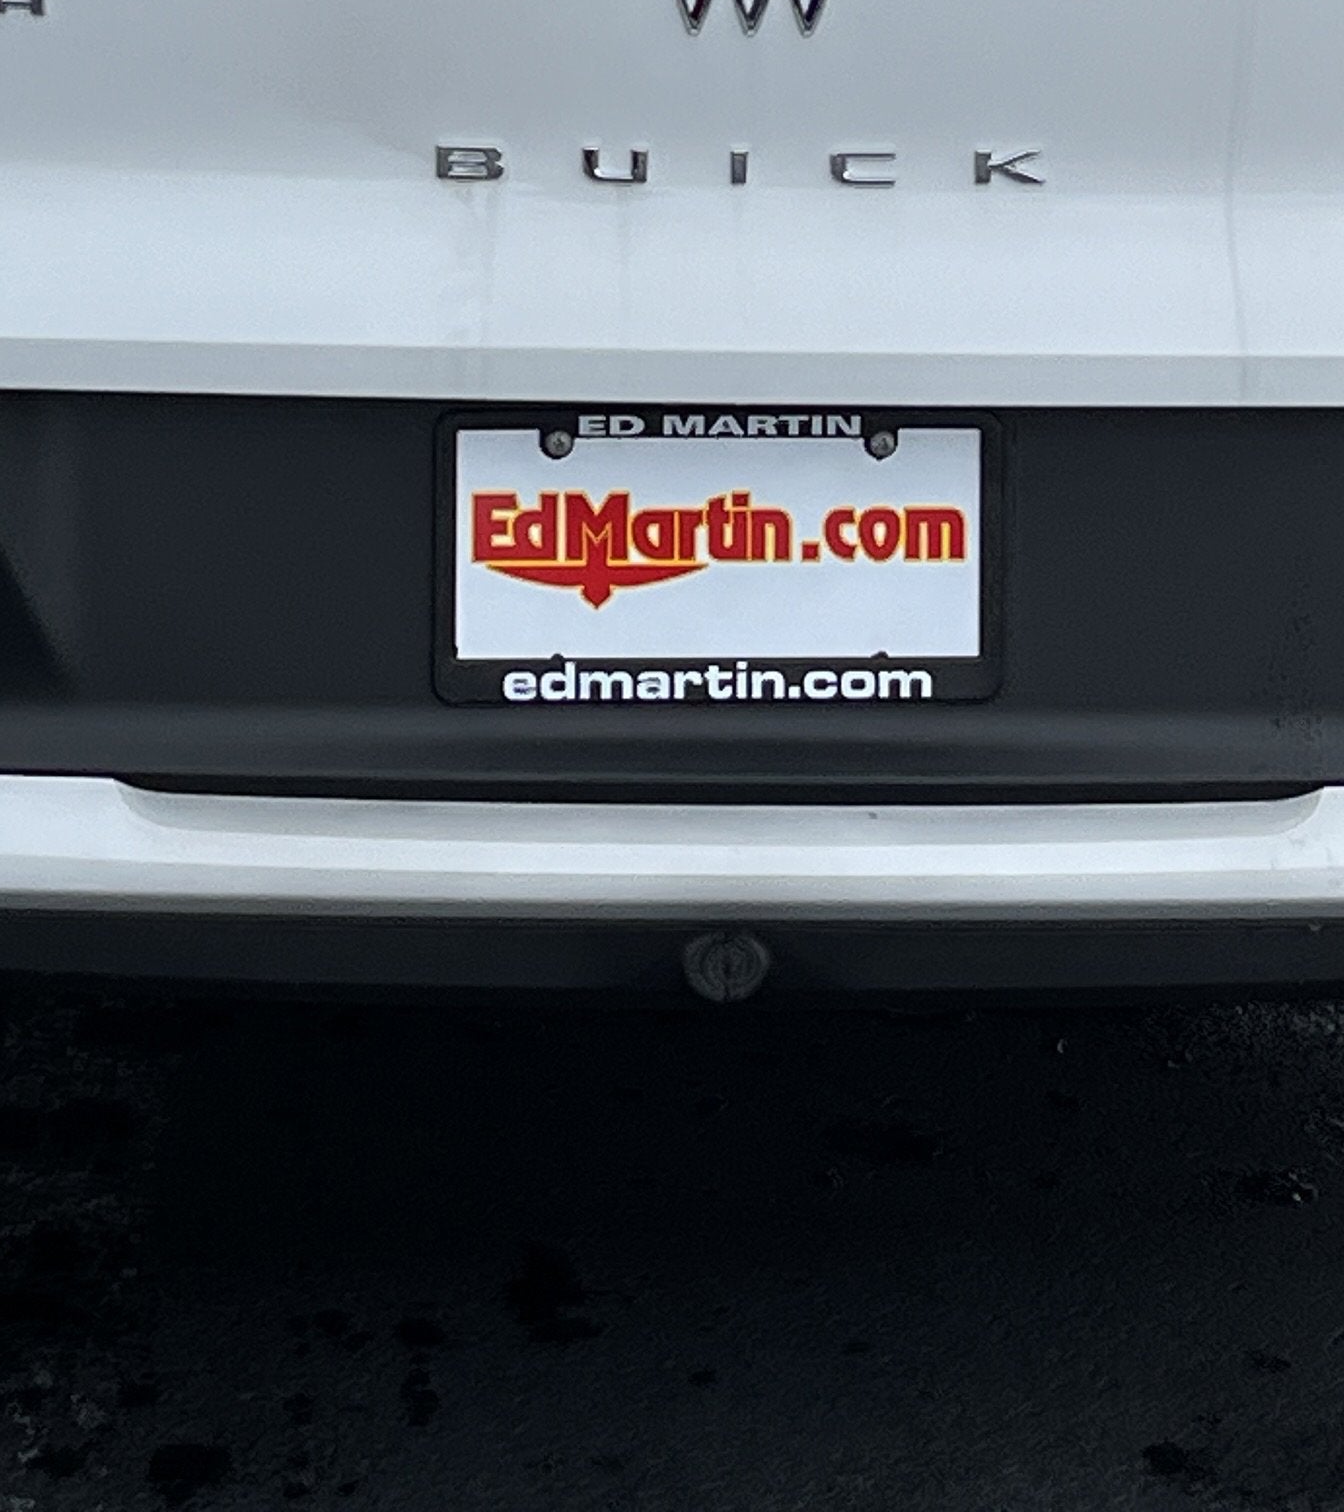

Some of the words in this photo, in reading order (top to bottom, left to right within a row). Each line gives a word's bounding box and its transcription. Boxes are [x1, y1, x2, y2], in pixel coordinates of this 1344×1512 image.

[436, 145, 1046, 186] BUICK
[578, 416, 645, 437] ED
[662, 415, 863, 437] MARTIN
[471, 491, 966, 563] EdMartin.com
[503, 662, 933, 701] edmartin.com
